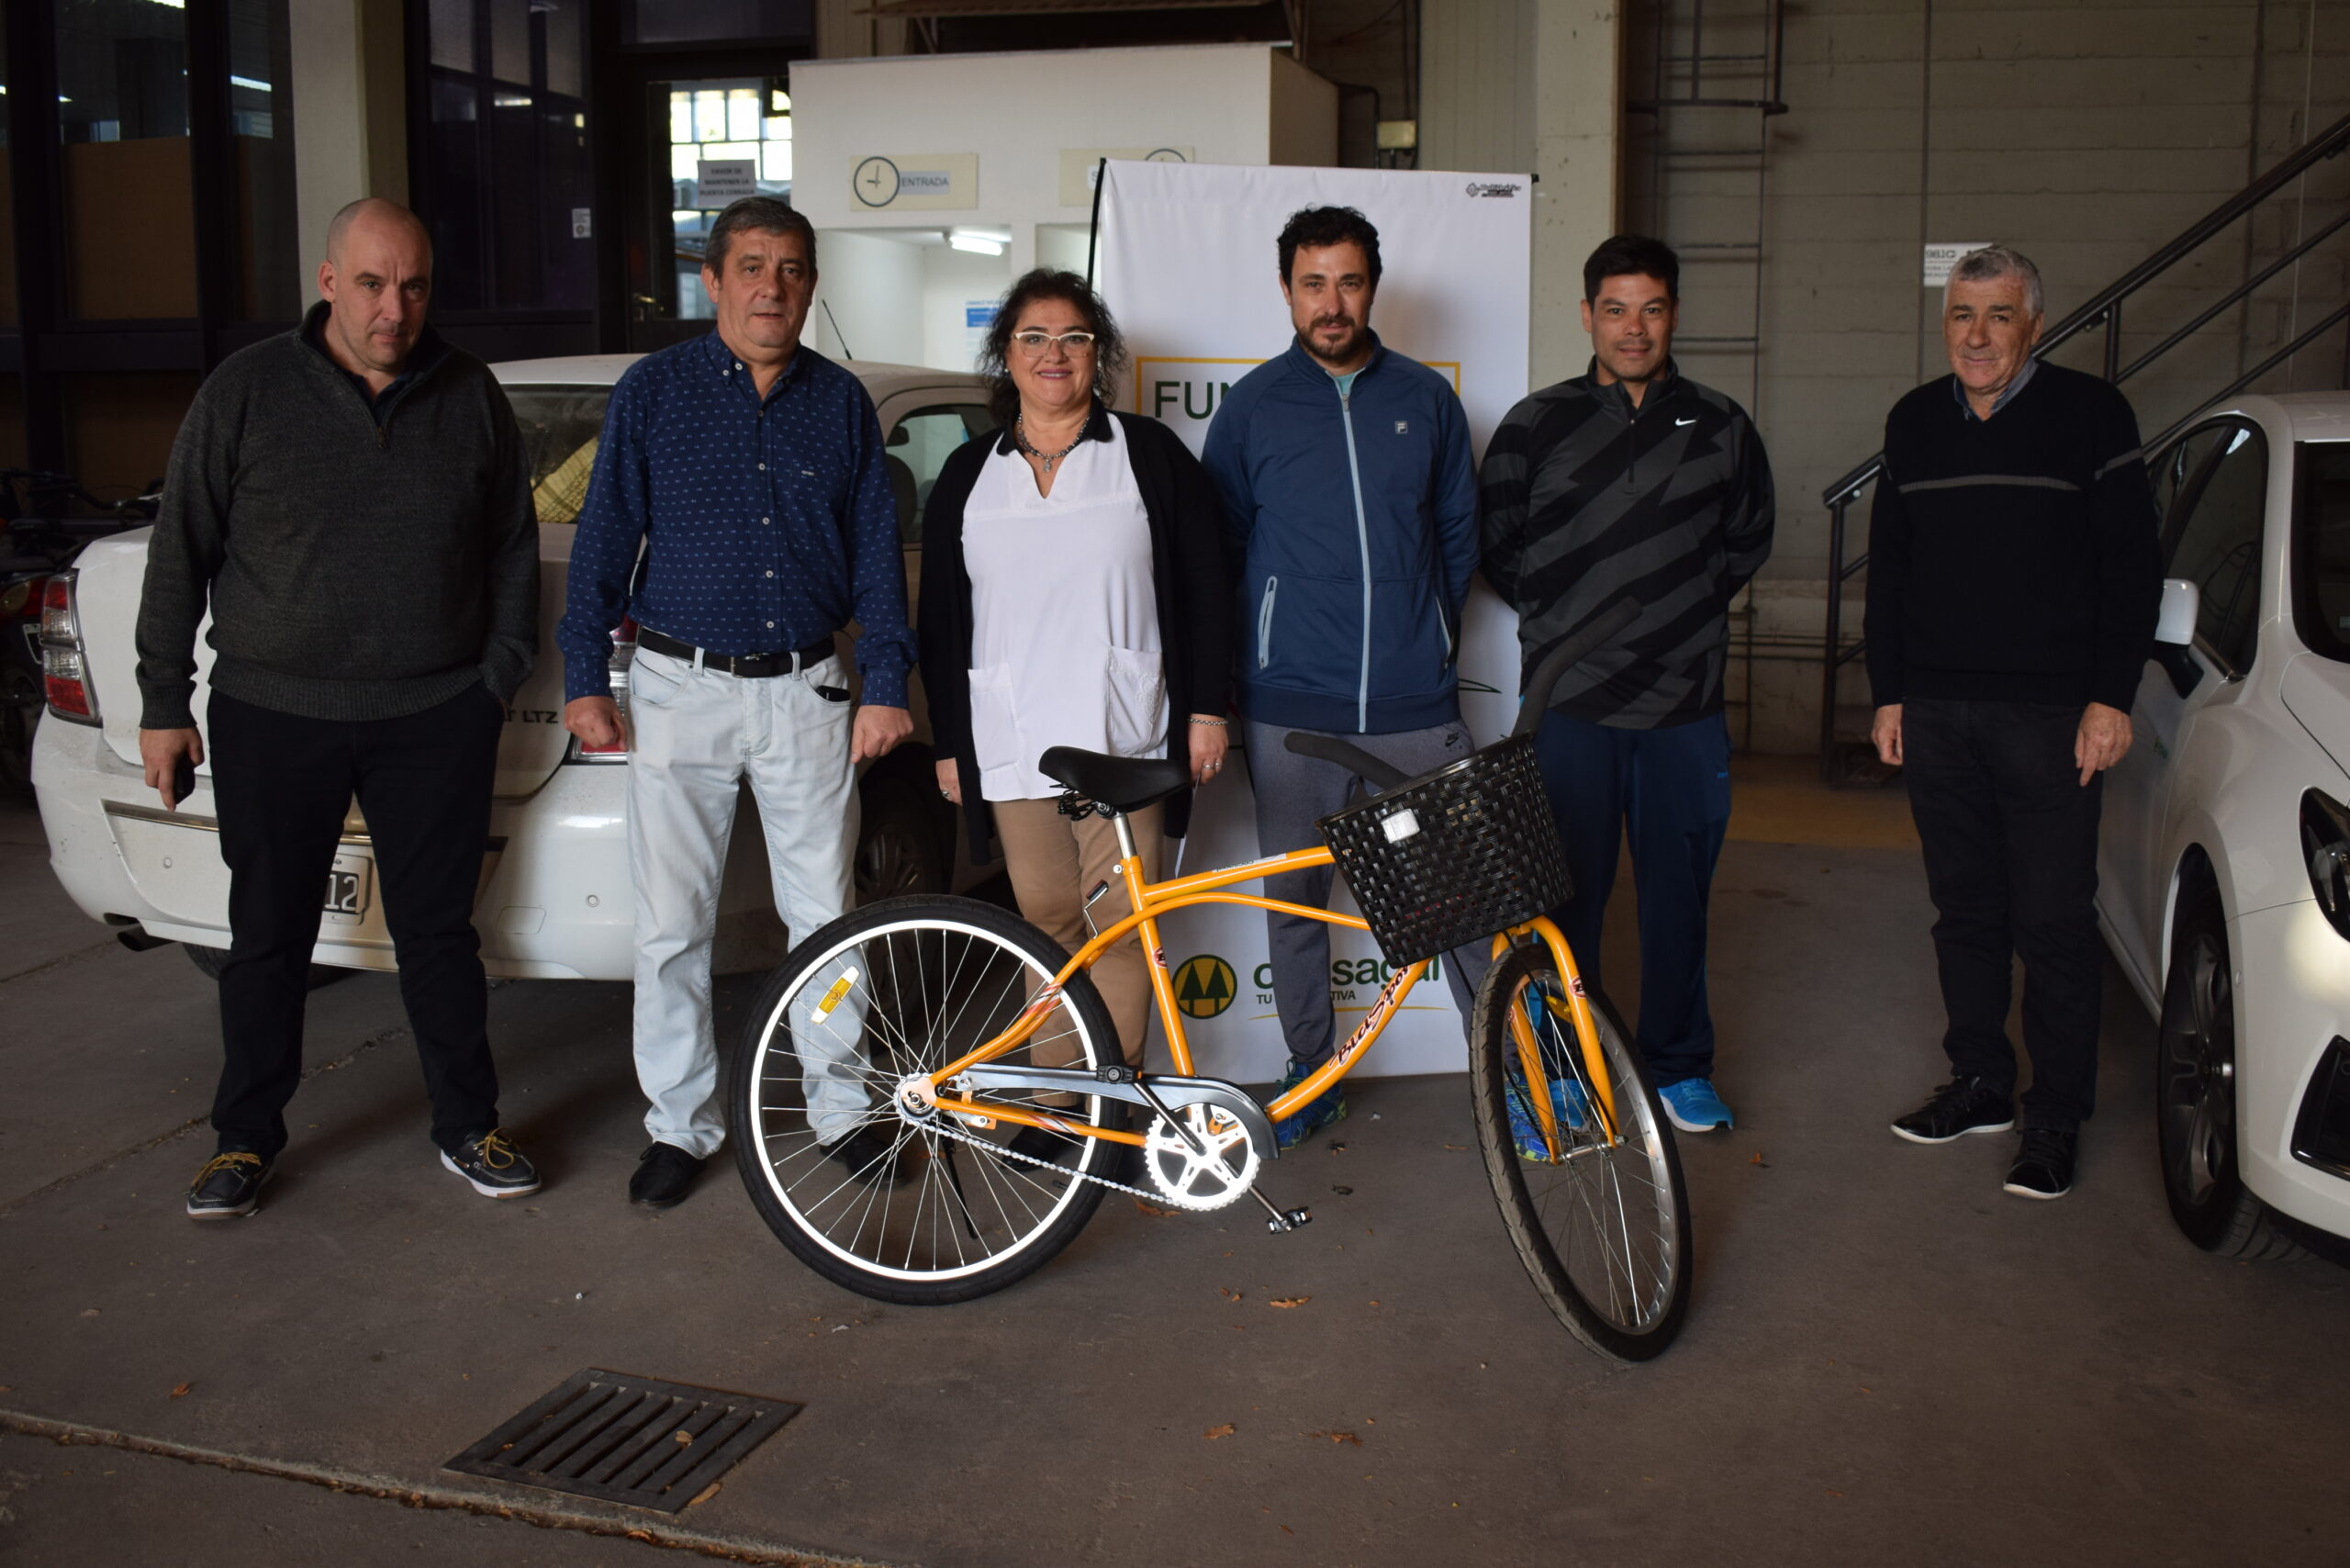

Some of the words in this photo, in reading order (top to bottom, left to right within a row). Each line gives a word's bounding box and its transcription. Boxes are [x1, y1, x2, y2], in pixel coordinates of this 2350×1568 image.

[901, 177, 949, 186] ENTRADA
[522, 710, 559, 723] LTZ
[1256, 994, 1272, 1004] TU
[1331, 990, 1356, 1001] TIVA
